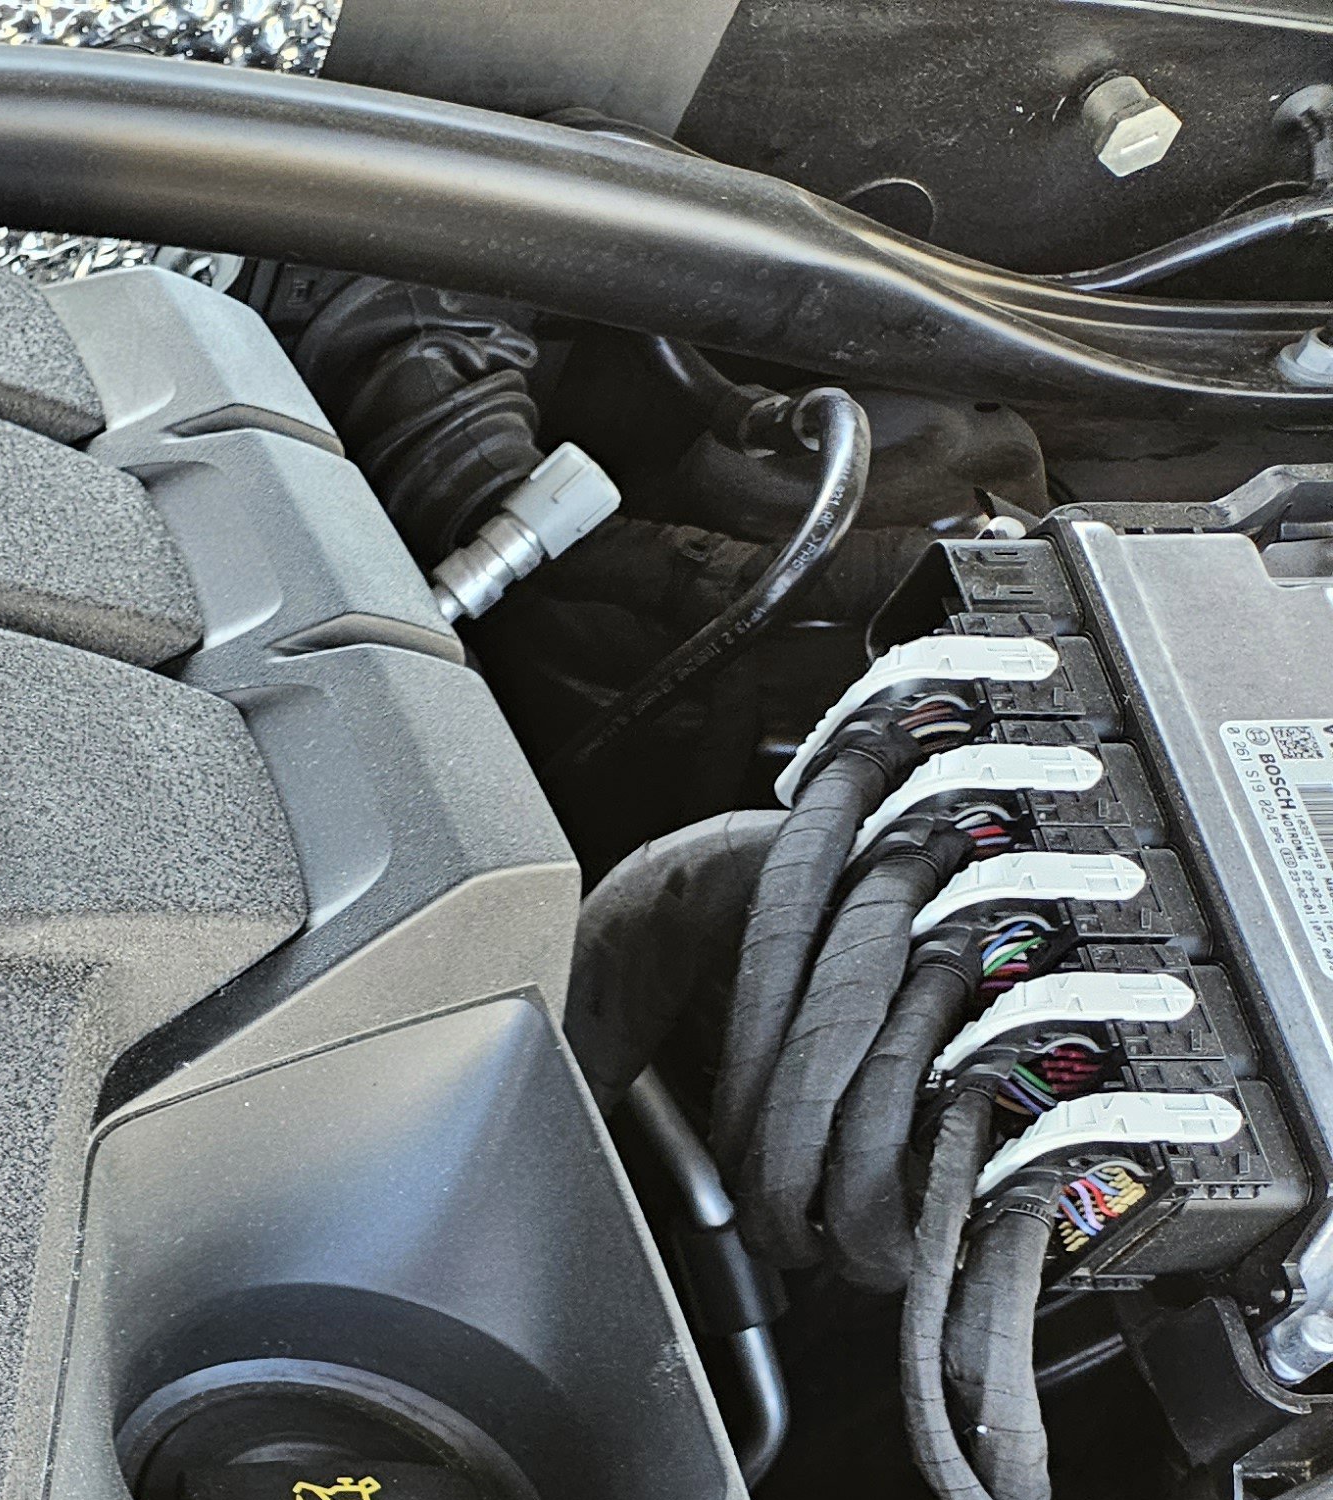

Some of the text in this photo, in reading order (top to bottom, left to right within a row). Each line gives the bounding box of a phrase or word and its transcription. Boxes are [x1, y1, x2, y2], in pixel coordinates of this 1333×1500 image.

[1233, 741, 1253, 762] 261
[1245, 770, 1266, 793] S19
[1258, 753, 1297, 810] BOSCH
[1280, 813, 1309, 861] MOTRONIC
